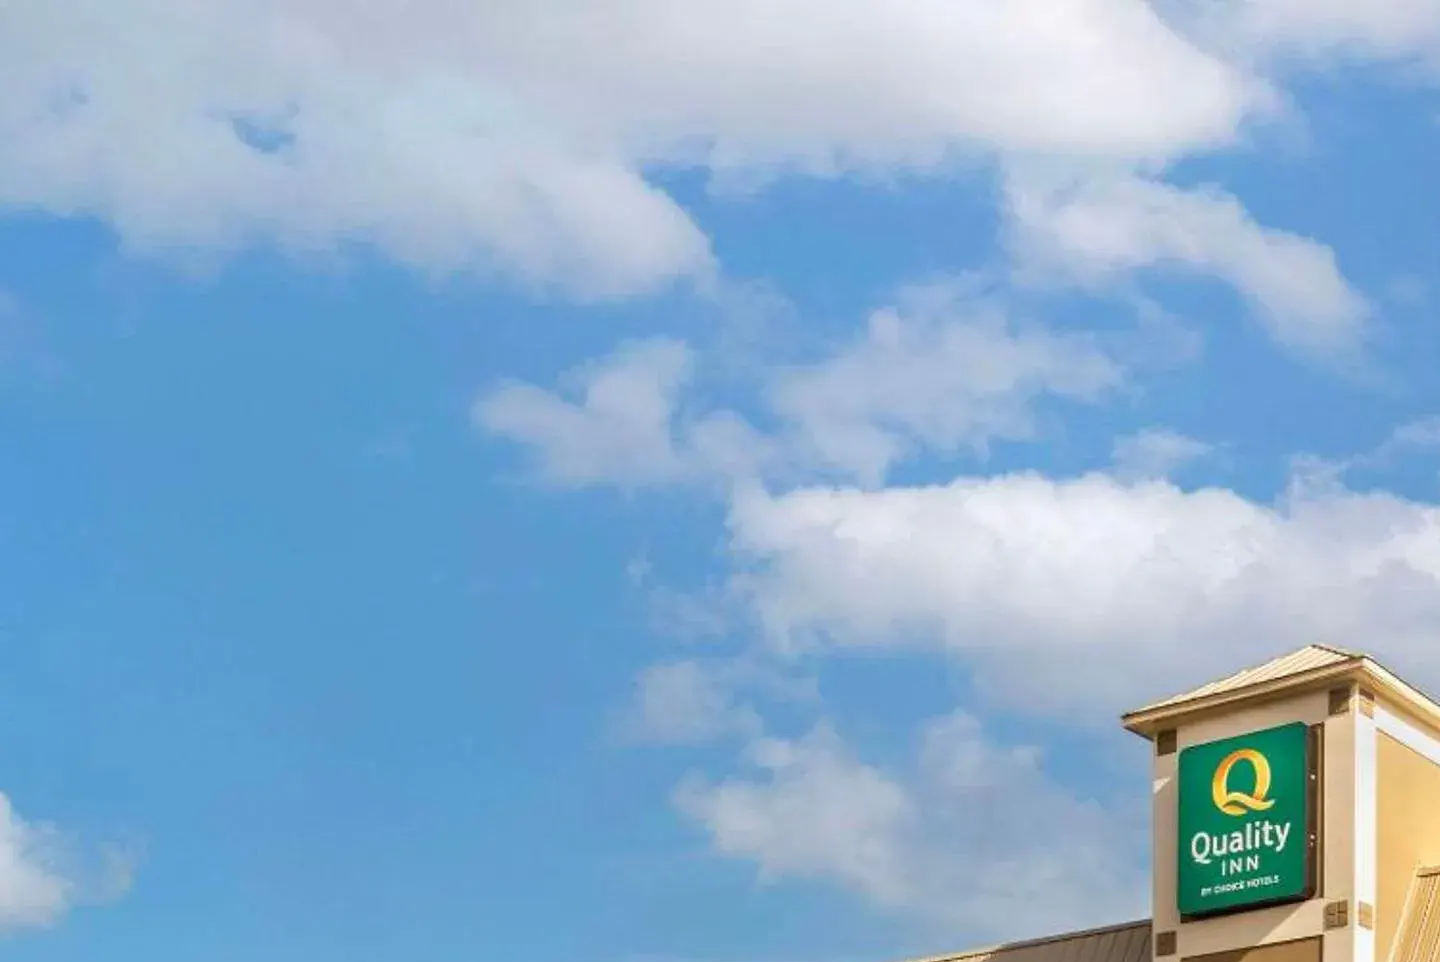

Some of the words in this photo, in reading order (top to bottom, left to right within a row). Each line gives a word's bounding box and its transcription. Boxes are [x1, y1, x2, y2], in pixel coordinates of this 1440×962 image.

[1212, 748, 1275, 816] Q
[1191, 820, 1290, 864] Quality
[1222, 855, 1259, 876] INN
[1246, 874, 1280, 889] HOTELS
